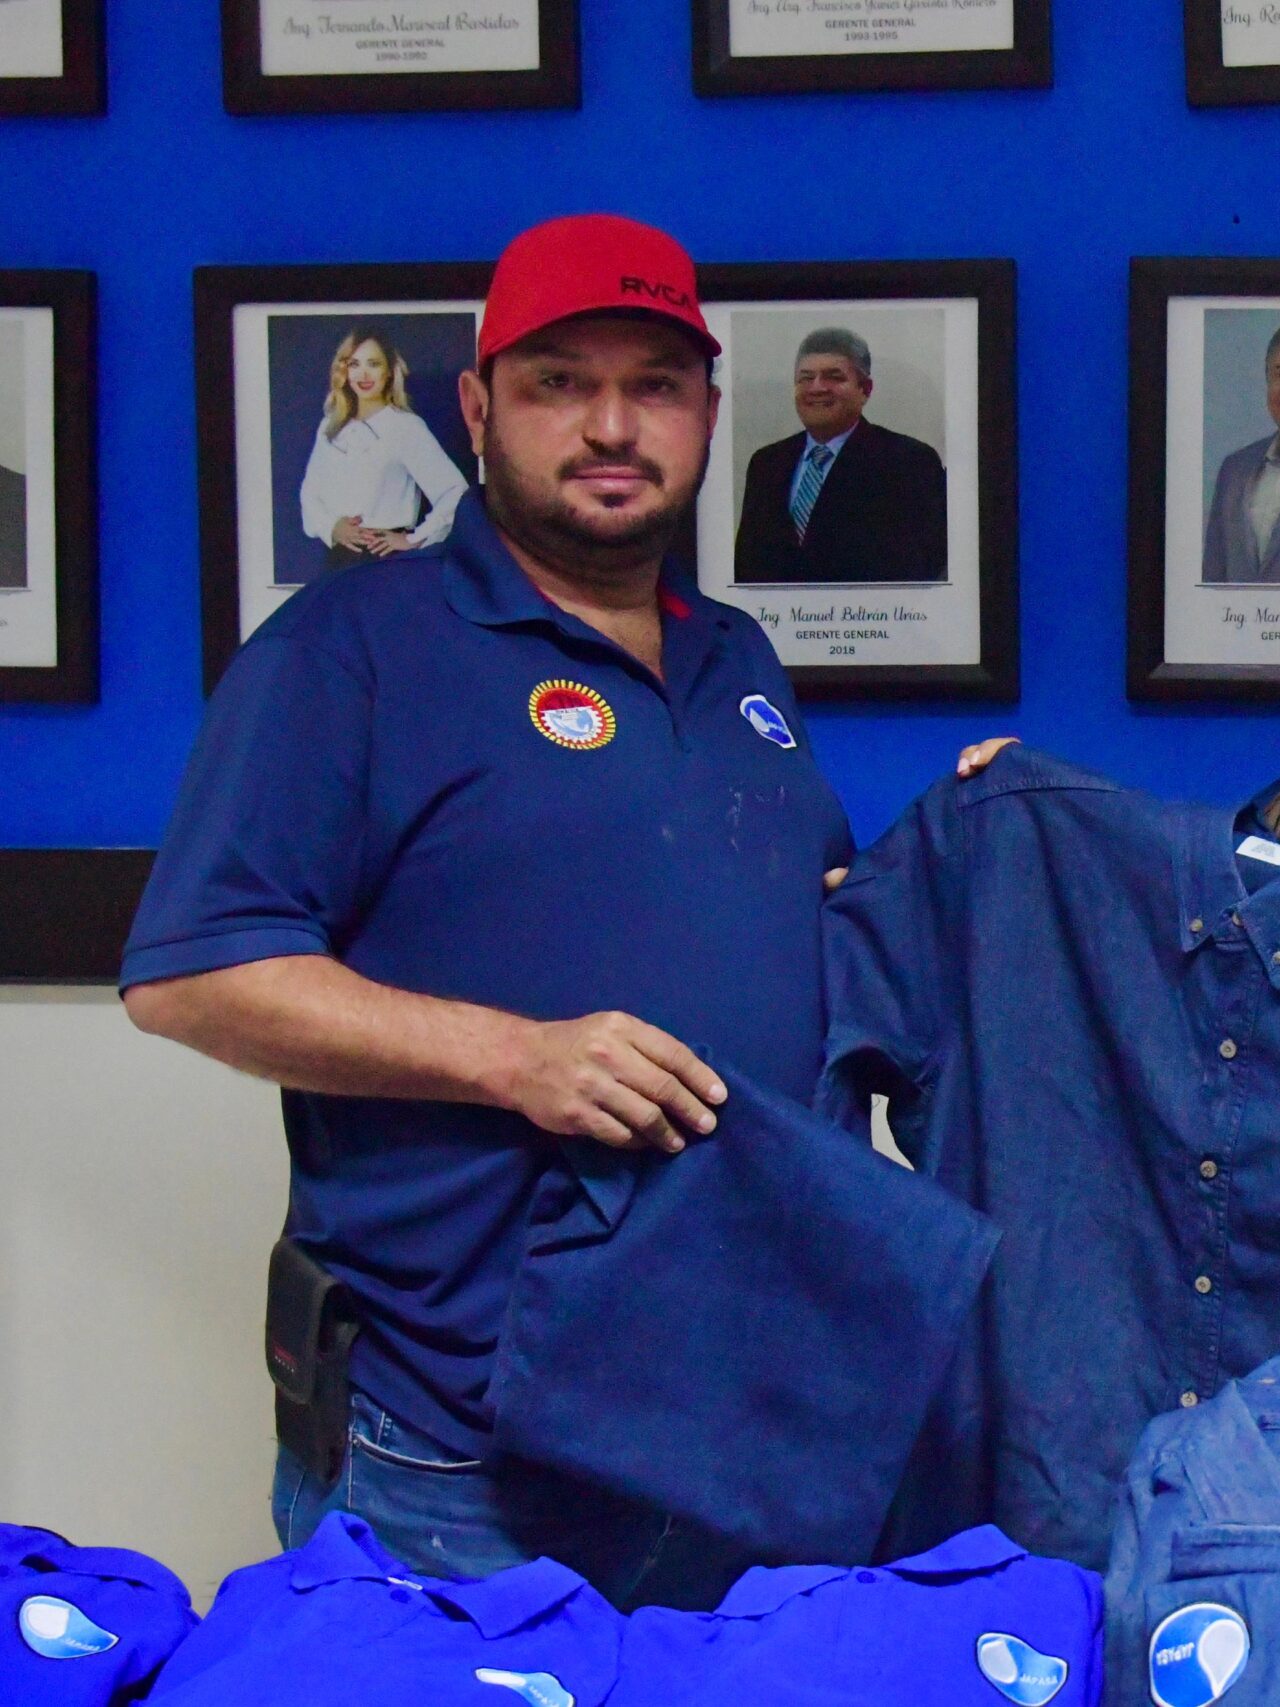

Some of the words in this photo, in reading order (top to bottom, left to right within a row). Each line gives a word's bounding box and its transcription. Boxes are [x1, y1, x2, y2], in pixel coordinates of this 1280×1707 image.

[825, 19, 869, 29] GERENTE
[871, 18, 917, 28] GENERAL
[356, 39, 400, 51] GERENTE
[401, 37, 445, 49] GENERAL
[790, 605, 835, 623] Manuel
[841, 605, 888, 622] Beltrán
[796, 630, 841, 640] GERENTE
[843, 630, 890, 640] GENERAL
[829, 646, 856, 655] 2018
